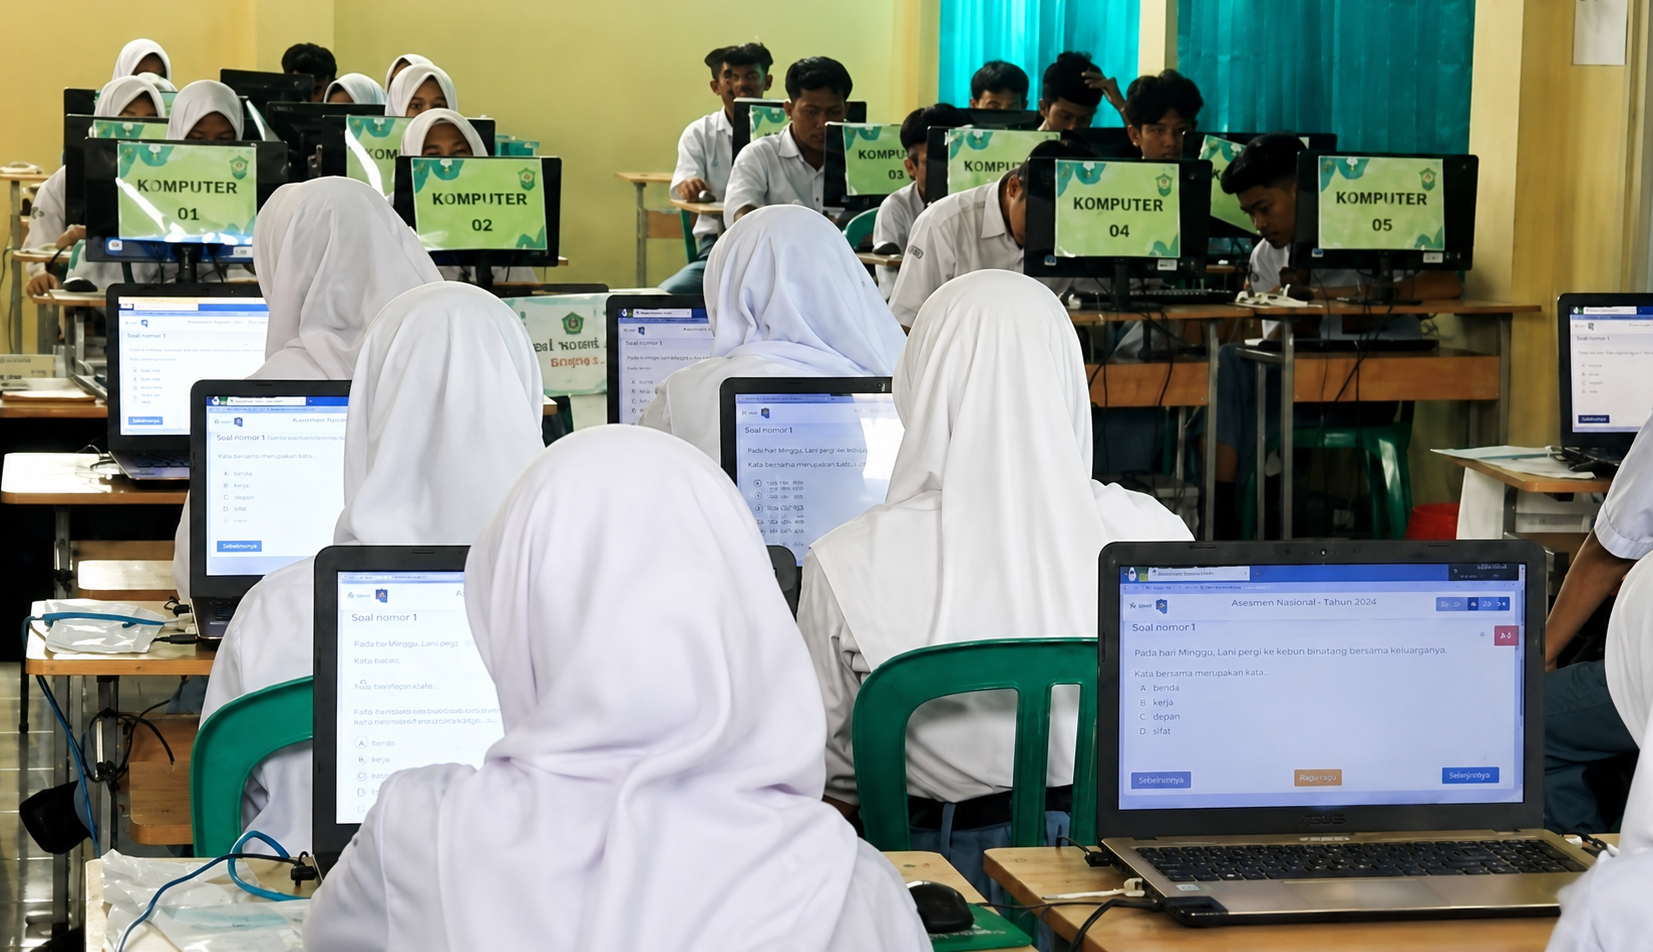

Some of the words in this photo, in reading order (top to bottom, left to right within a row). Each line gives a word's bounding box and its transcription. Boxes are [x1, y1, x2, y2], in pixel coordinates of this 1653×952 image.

[888, 169, 905, 180] 03
[137, 179, 238, 195] KOMPUTER
[432, 192, 528, 206] KOMPUTER
[1073, 196, 1164, 212] KOMPUTER
[1336, 191, 1428, 206] KOMPUTER
[177, 207, 200, 221] 01
[471, 219, 493, 232] 02
[1109, 224, 1130, 238] 04
[1372, 218, 1393, 232] 05
[1231, 598, 1274, 607] Asesmen
[1276, 598, 1316, 607] Nasional
[1323, 598, 1352, 607] Tahun
[1354, 598, 1377, 606] 2024
[351, 613, 373, 622] Soal
[376, 614, 410, 622] nomor
[1132, 623, 1153, 632] Soal
[1156, 624, 1190, 632] nomor
[1191, 623, 1196, 631] 1
[1135, 649, 1157, 657] Pada
[1159, 648, 1176, 657] hari
[1178, 648, 1215, 659] Minggu,
[1217, 648, 1236, 656] Lani
[1238, 648, 1262, 658] pergi
[1264, 647, 1274, 656] ke
[1276, 647, 1304, 656] kebun
[1307, 647, 1348, 657] binatang
[1349, 647, 1389, 655] bersama
[1390, 646, 1448, 657] keluarganya.
[1135, 670, 1154, 678] Kata
[1156, 670, 1193, 678] bersama
[1195, 669, 1243, 679] merupakan
[1153, 684, 1180, 692] benda
[1153, 699, 1174, 708] kerja
[1153, 712, 1181, 722] depan
[1153, 727, 1171, 735] sifat
